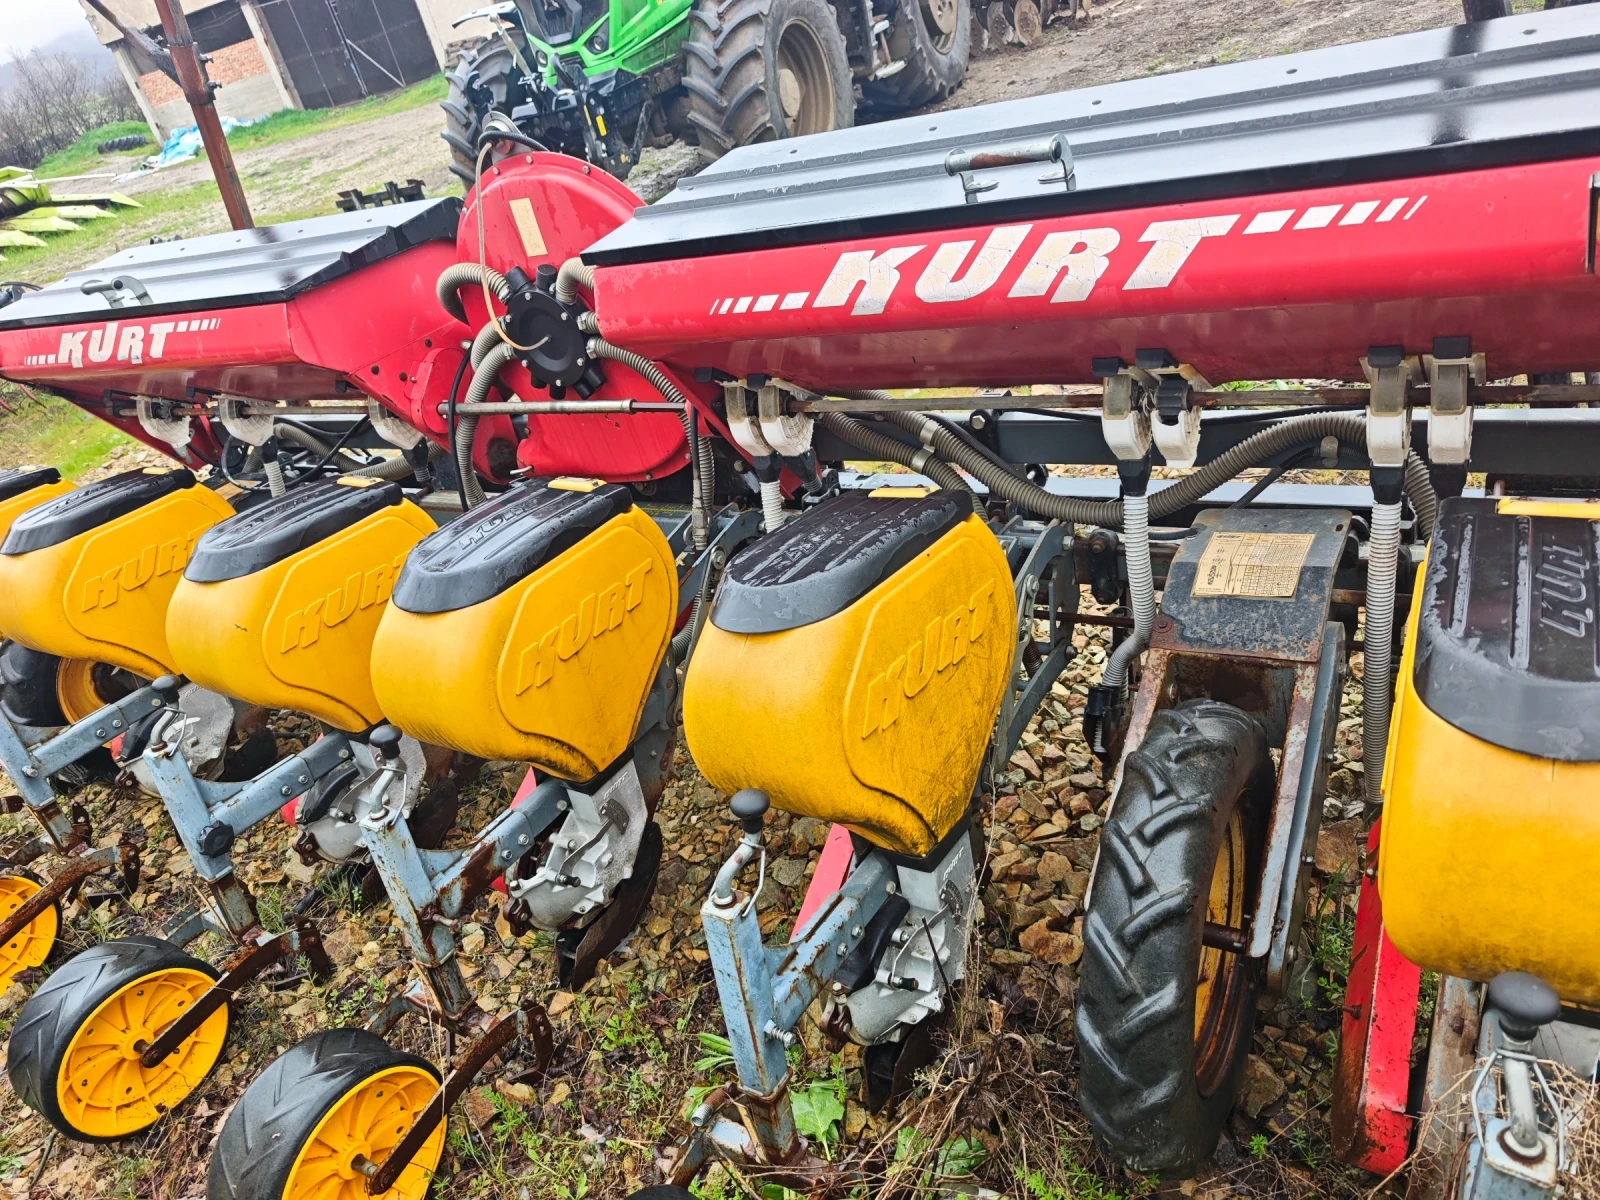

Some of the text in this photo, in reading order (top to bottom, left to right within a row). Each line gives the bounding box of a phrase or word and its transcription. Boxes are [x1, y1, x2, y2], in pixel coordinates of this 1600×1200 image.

[812, 214, 1241, 315] KURT
[58, 322, 176, 368] KURT
[281, 551, 411, 654] KUR
[516, 557, 652, 696] KURT
[862, 578, 995, 739] KURT
